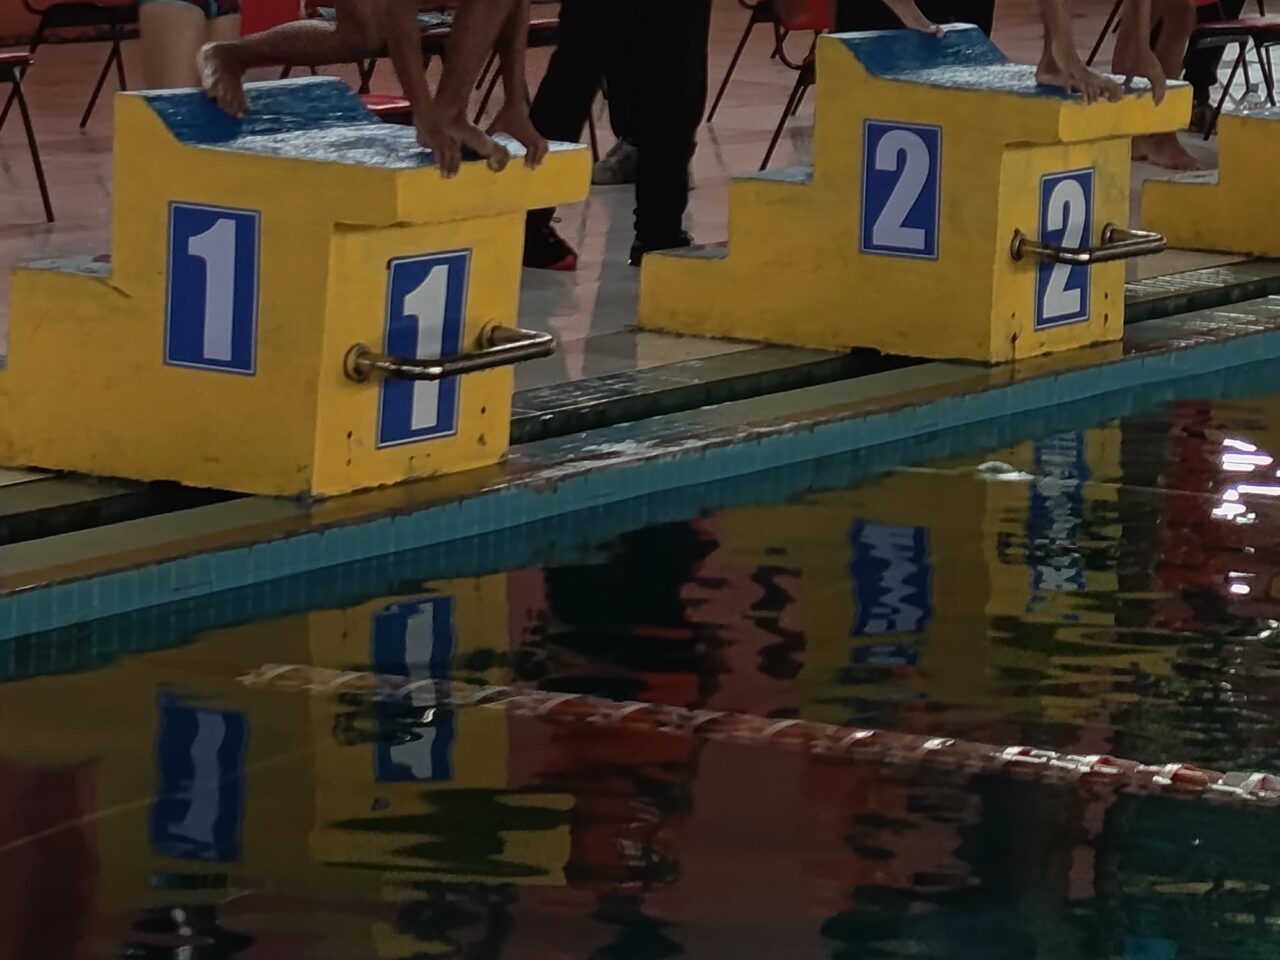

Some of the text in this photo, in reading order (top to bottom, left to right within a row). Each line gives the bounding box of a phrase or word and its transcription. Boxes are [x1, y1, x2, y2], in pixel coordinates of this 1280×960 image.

[871, 129, 930, 250] 2
[1042, 179, 1086, 319] 2
[187, 218, 236, 361] 1
[403, 264, 449, 431] 1
